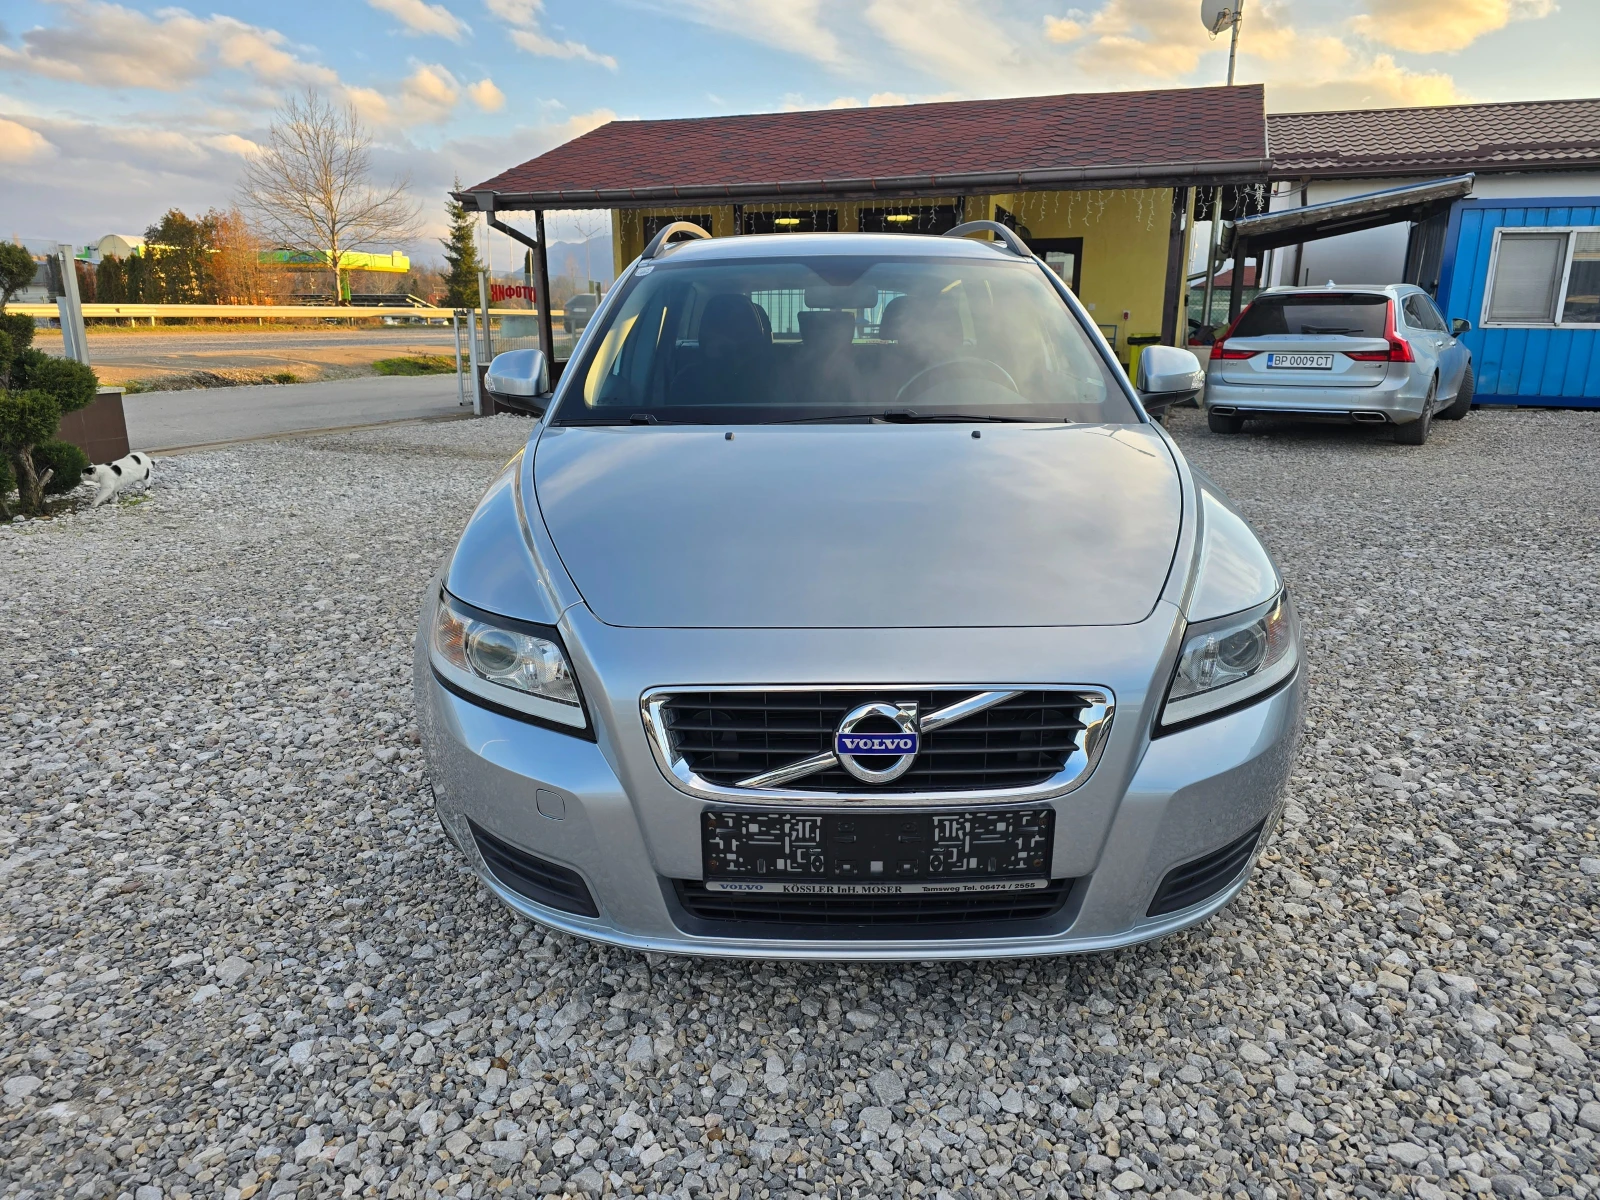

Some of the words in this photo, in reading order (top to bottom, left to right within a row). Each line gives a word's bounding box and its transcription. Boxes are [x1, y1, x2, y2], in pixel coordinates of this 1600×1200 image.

[1274, 355, 1288, 366] BP
[1289, 355, 1315, 366] 0009
[1316, 356, 1331, 367] CT
[842, 738, 912, 750] VOLVO
[719, 883, 764, 891] VOLVO
[782, 883, 834, 893] KÖSSLER
[861, 885, 903, 894] MOSER
